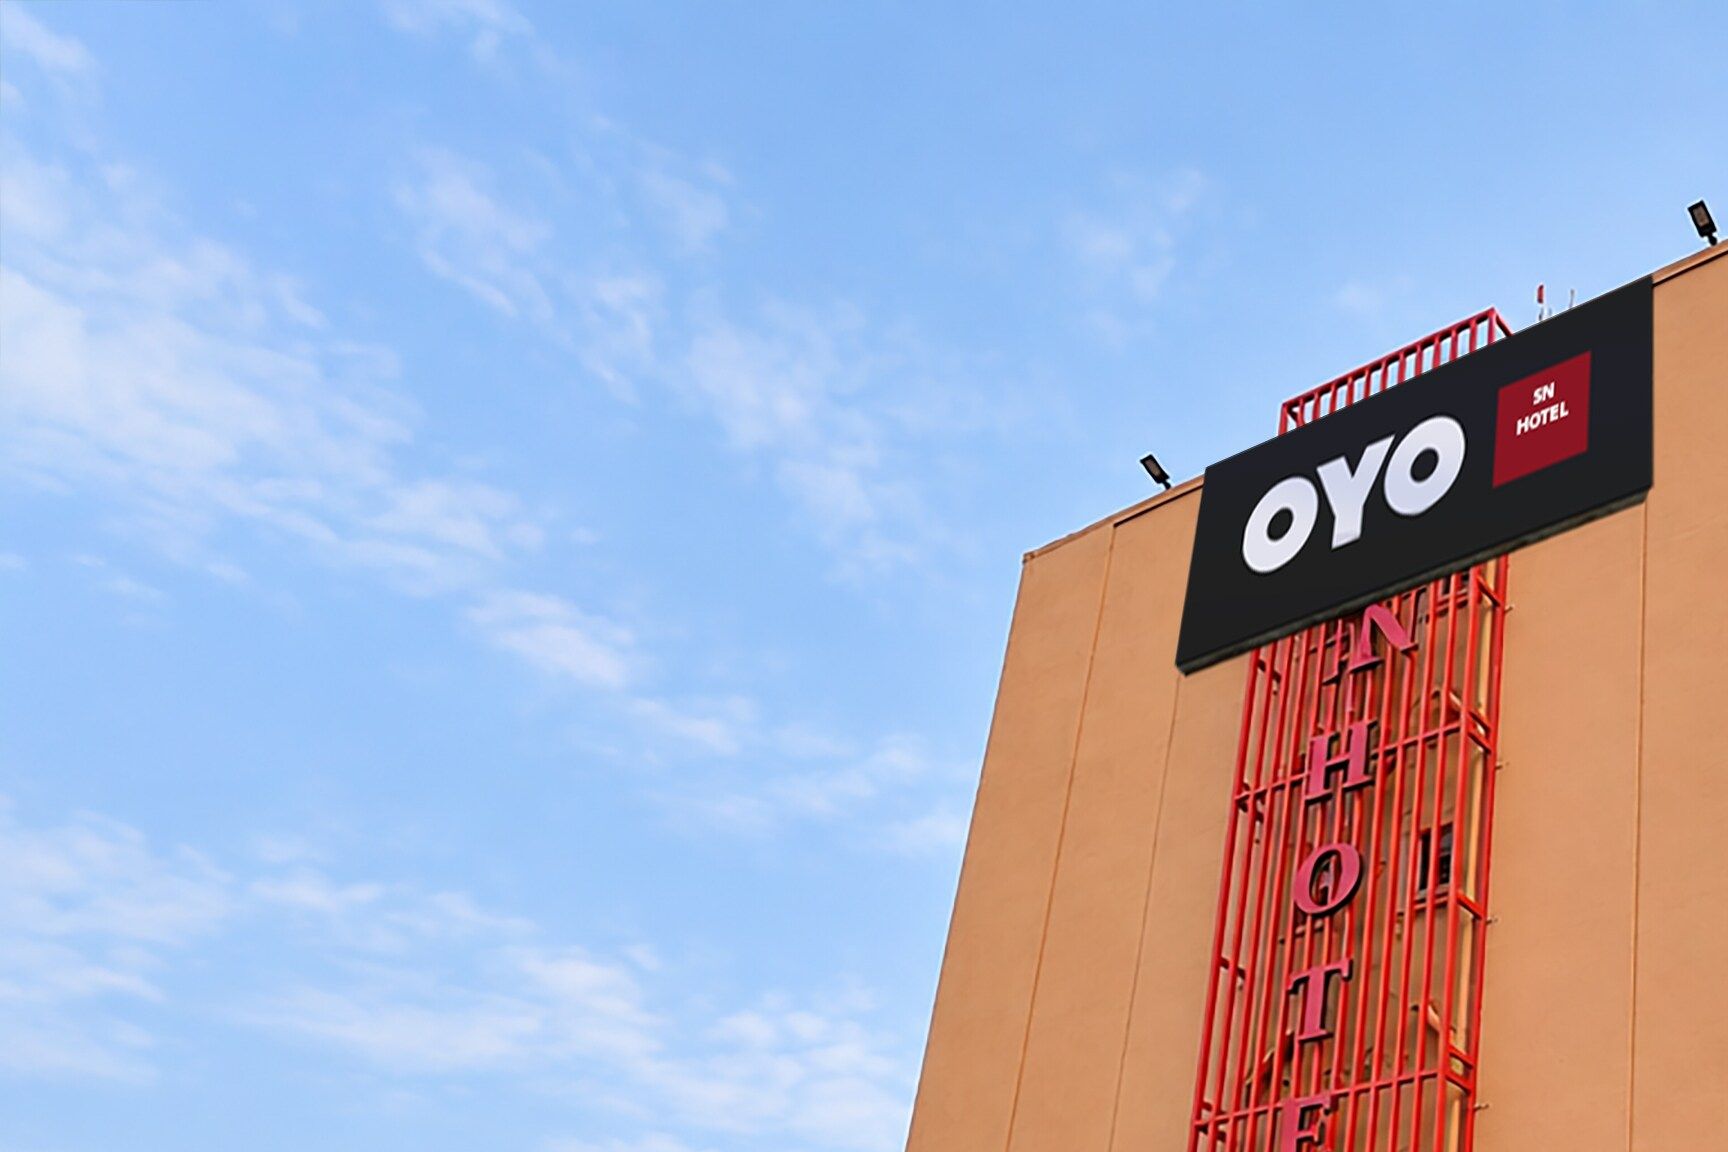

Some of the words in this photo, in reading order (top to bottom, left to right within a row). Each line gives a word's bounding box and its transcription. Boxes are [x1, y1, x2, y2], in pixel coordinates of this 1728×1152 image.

[1532, 381, 1556, 406] SN
[1516, 401, 1570, 436] HOTEL
[1242, 415, 1466, 573] OYO
